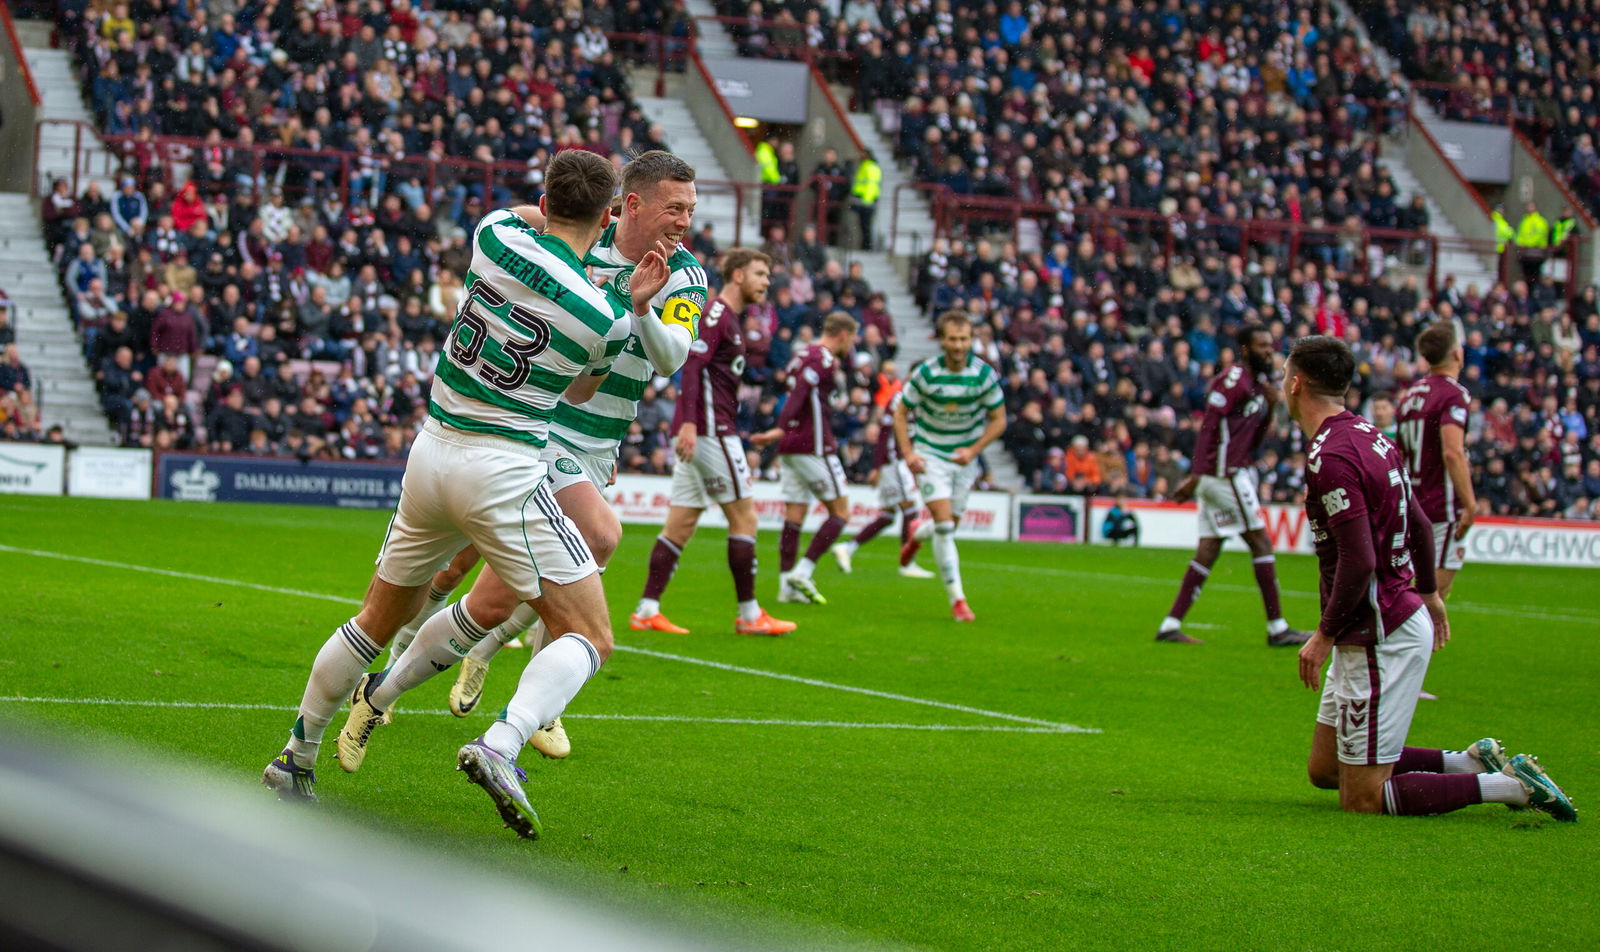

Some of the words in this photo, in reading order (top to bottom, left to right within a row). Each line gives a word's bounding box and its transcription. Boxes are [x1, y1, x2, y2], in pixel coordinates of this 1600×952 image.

[496, 247, 570, 302] TIERNEY
[673, 303, 690, 322] C
[450, 278, 551, 392] 63
[234, 472, 331, 493] DALMAHOY
[332, 477, 385, 497] HOTEL
